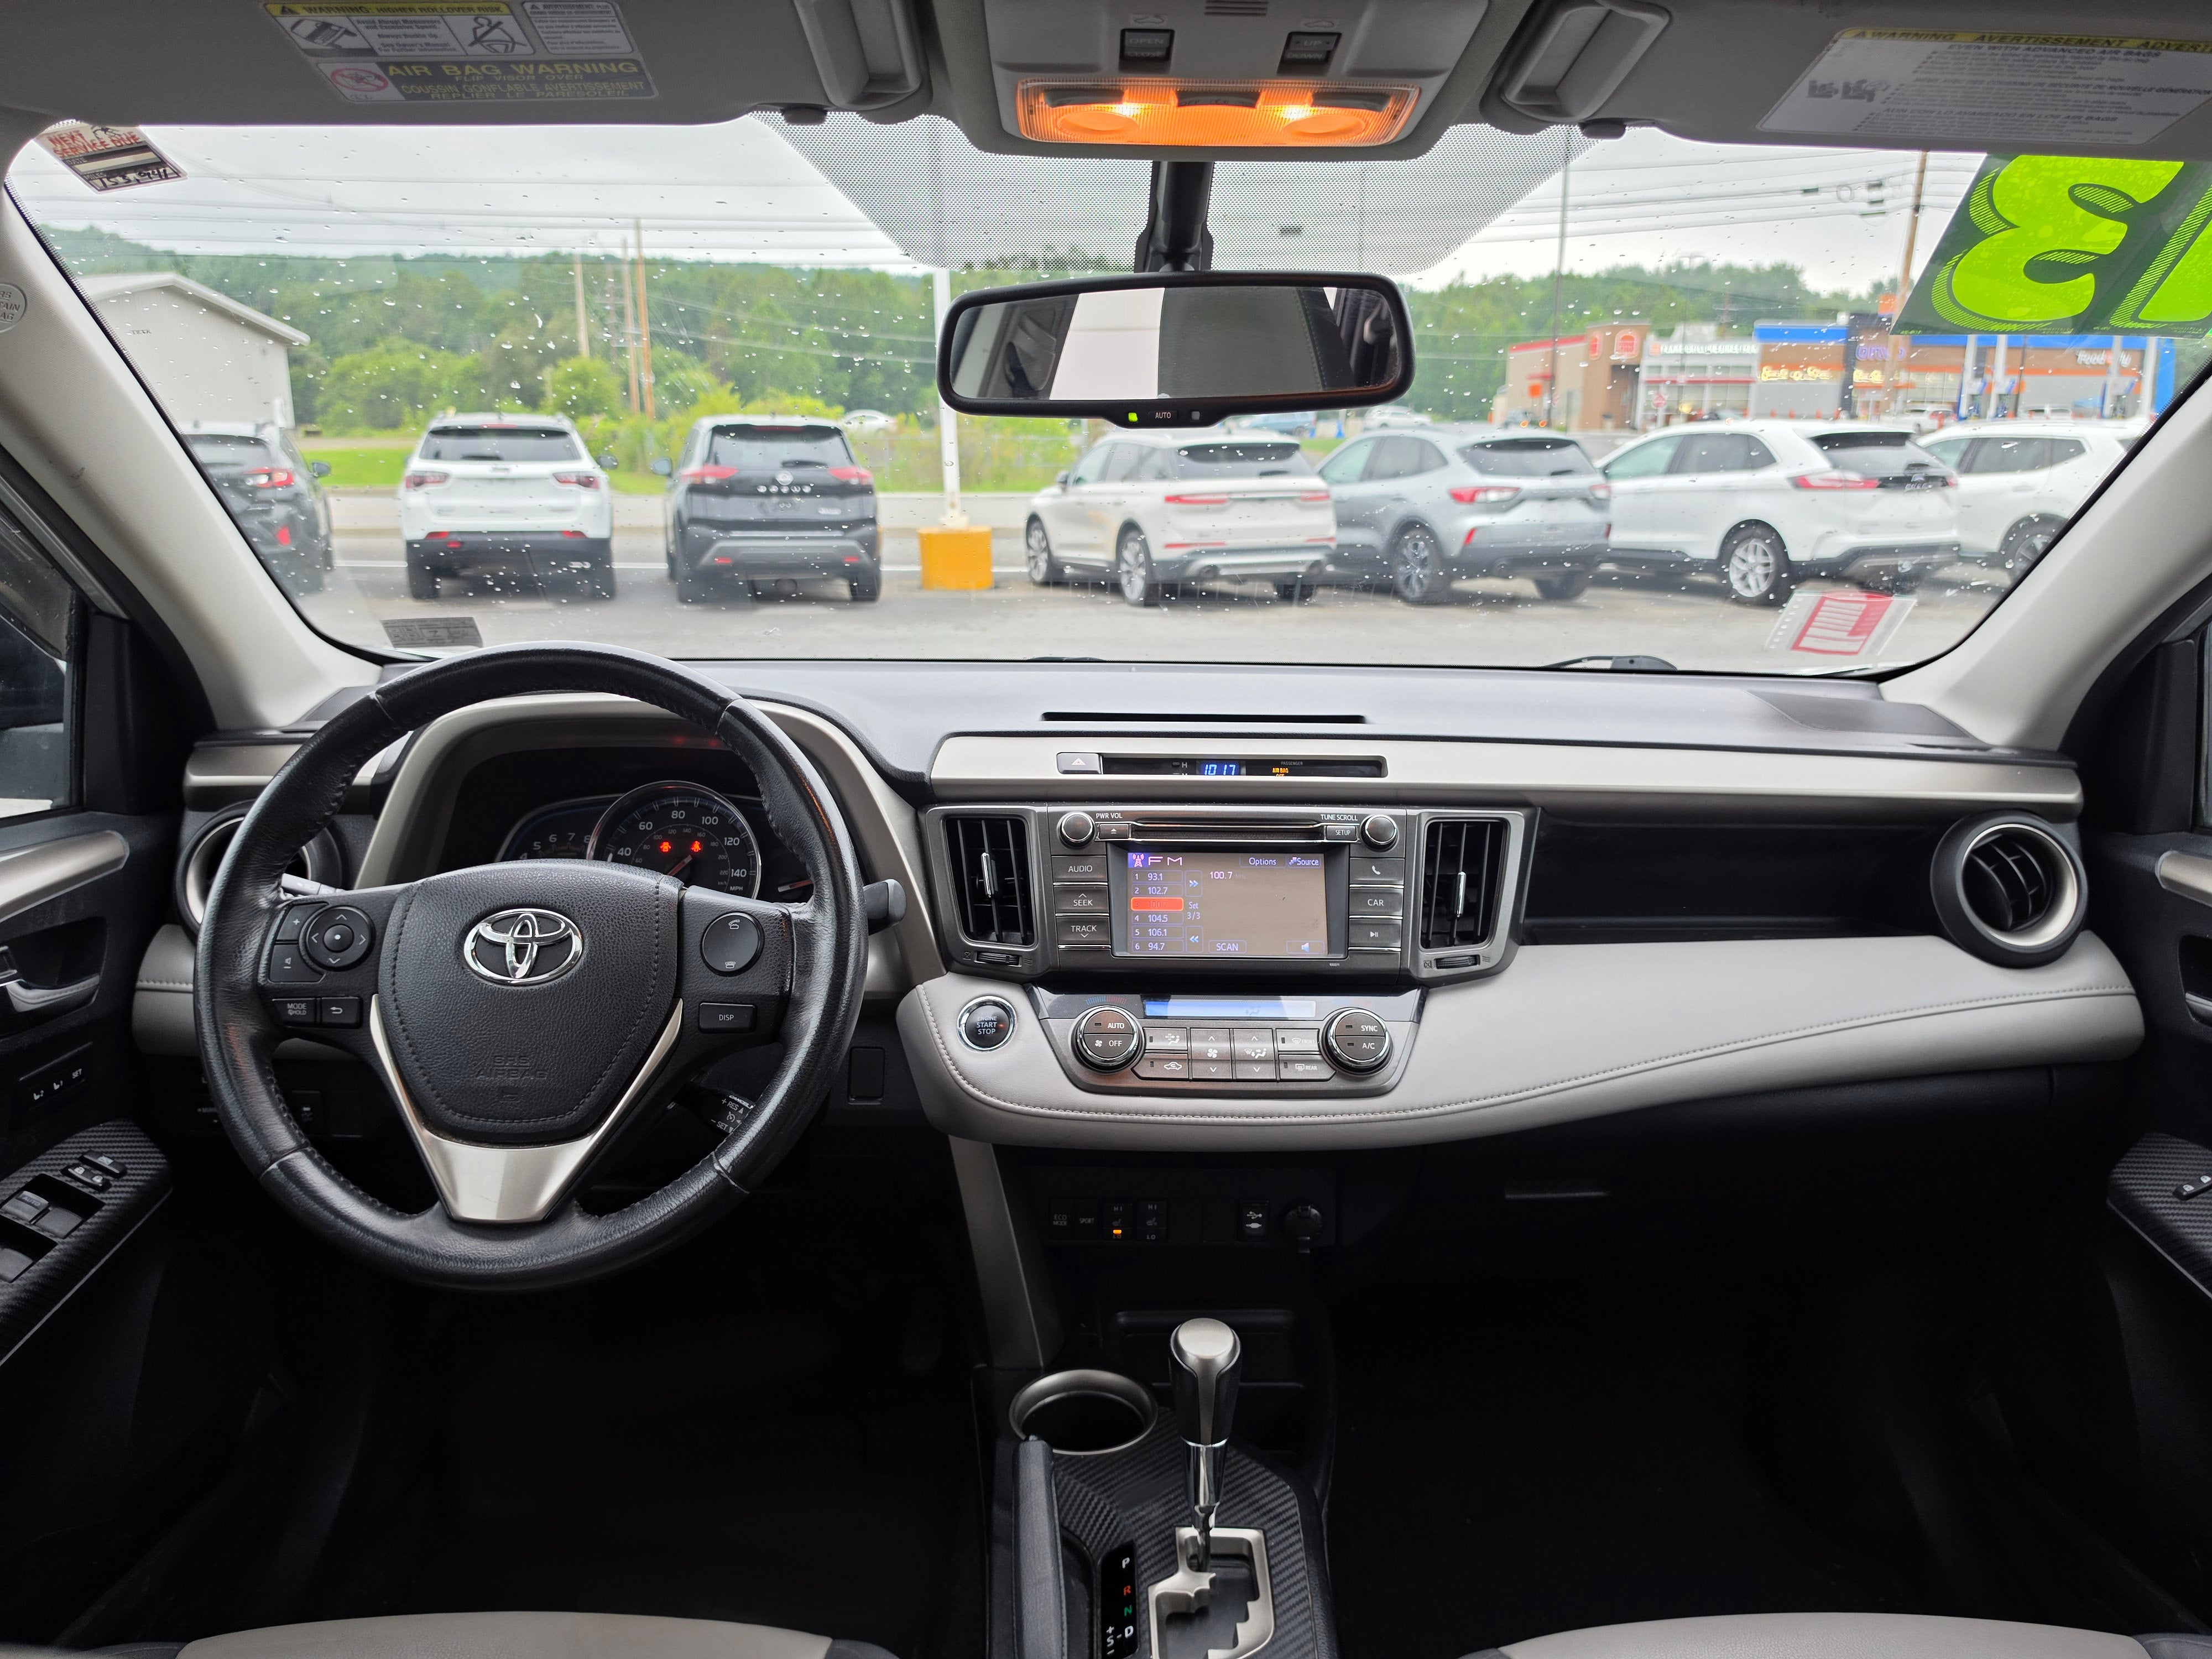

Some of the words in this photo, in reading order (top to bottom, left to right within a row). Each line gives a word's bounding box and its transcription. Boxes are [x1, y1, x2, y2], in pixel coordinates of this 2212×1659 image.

[388, 65, 432, 76] AIR
[441, 64, 502, 76] BAG
[510, 62, 639, 75] WARNING
[401, 85, 459, 93] COUSSIN
[462, 84, 540, 93] GONFLABLE
[545, 82, 644, 92] AVERTISSEMENT
[49, 129, 87, 148] NEXT
[53, 137, 113, 158] SERVICE
[109, 131, 143, 148] DUE
[66, 157, 88, 165] DATE
[83, 172, 107, 181] MILES
[671, 811, 685, 819] 80
[702, 816, 718, 825] 100
[639, 822, 653, 830] 60
[549, 834, 557, 842] 6
[568, 833, 576, 841] 7
[724, 837, 740, 846] 120
[533, 841, 541, 850] 5
[617, 847, 632, 856] 40
[1249, 857, 1277, 867] Options
[1297, 857, 1319, 867] Source
[731, 869, 747, 877] 140
[1068, 864, 1093, 873] AUDIO
[1147, 871, 1163, 881] 93.1
[1209, 870, 1233, 880] 100.7
[1147, 885, 1168, 895] 102.7
[1147, 900, 1168, 909] 100.7
[1188, 901, 1199, 910] Set
[1366, 898, 1384, 906] CAR
[1147, 914, 1168, 923] 104.5
[1187, 911, 1201, 921] 3/3
[1070, 925, 1097, 933] TRACK
[1147, 928, 1168, 937] 106.1
[1147, 941, 1166, 951] 94.7
[1216, 942, 1239, 952] SCAN
[727, 1101, 739, 1111] RES
[729, 1094, 752, 1109] CANCEL
[717, 1121, 729, 1131] SET
[24, 1196, 41, 1206] AUTO
[1122, 1557, 1130, 1569] P
[1123, 1585, 1132, 1597] R
[1124, 1605, 1133, 1616] N
[1125, 1625, 1134, 1638] D
[1107, 1635, 1115, 1647] S
